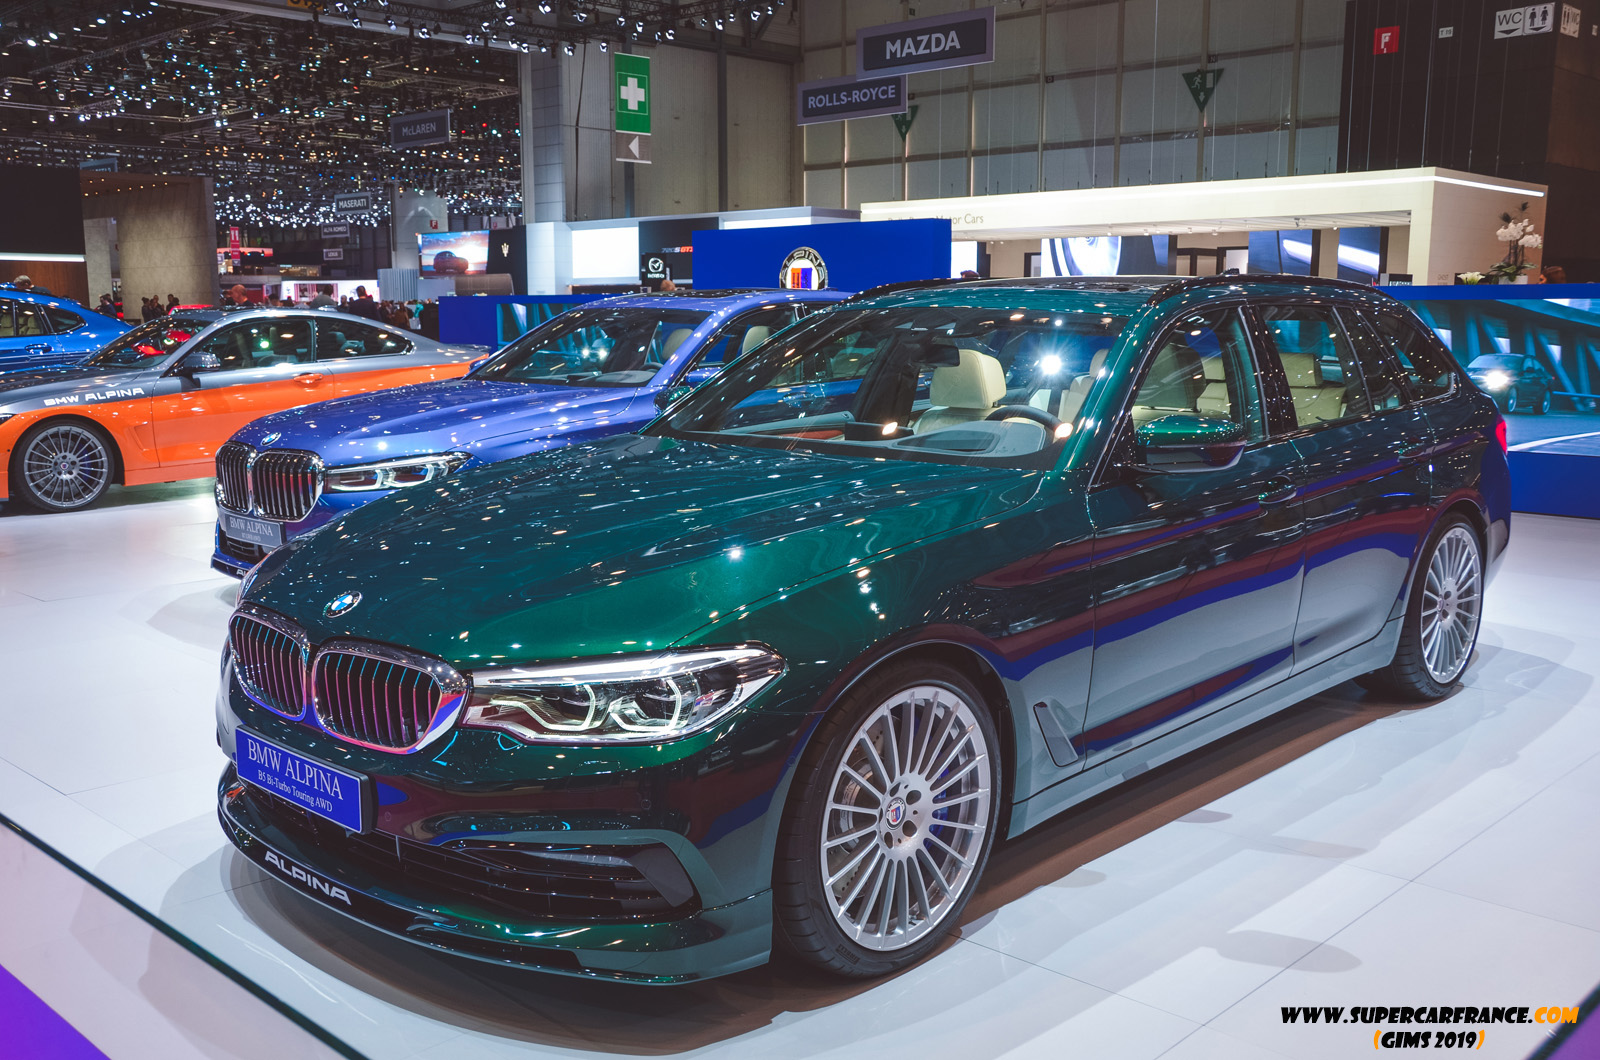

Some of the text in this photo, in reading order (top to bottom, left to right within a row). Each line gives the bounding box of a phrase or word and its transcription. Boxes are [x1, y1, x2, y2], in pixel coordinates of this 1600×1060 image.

[1497, 11, 1522, 26] WC
[886, 31, 960, 59] MAZDA
[1381, 33, 1391, 49] F
[808, 84, 896, 109] ROLLS-ROYCE
[402, 122, 436, 136] McLAREN
[338, 199, 367, 209] MASERATI
[964, 213, 984, 224] Cars
[782, 250, 825, 284] ALPINA
[43, 387, 145, 406] BMW ALPINA
[230, 517, 273, 536] BMW ALPINA
[247, 738, 344, 801] BMW ALPINA
[258, 769, 333, 812] B5 Bi-Turbo Touring AWD
[264, 850, 352, 906] ALPINA
